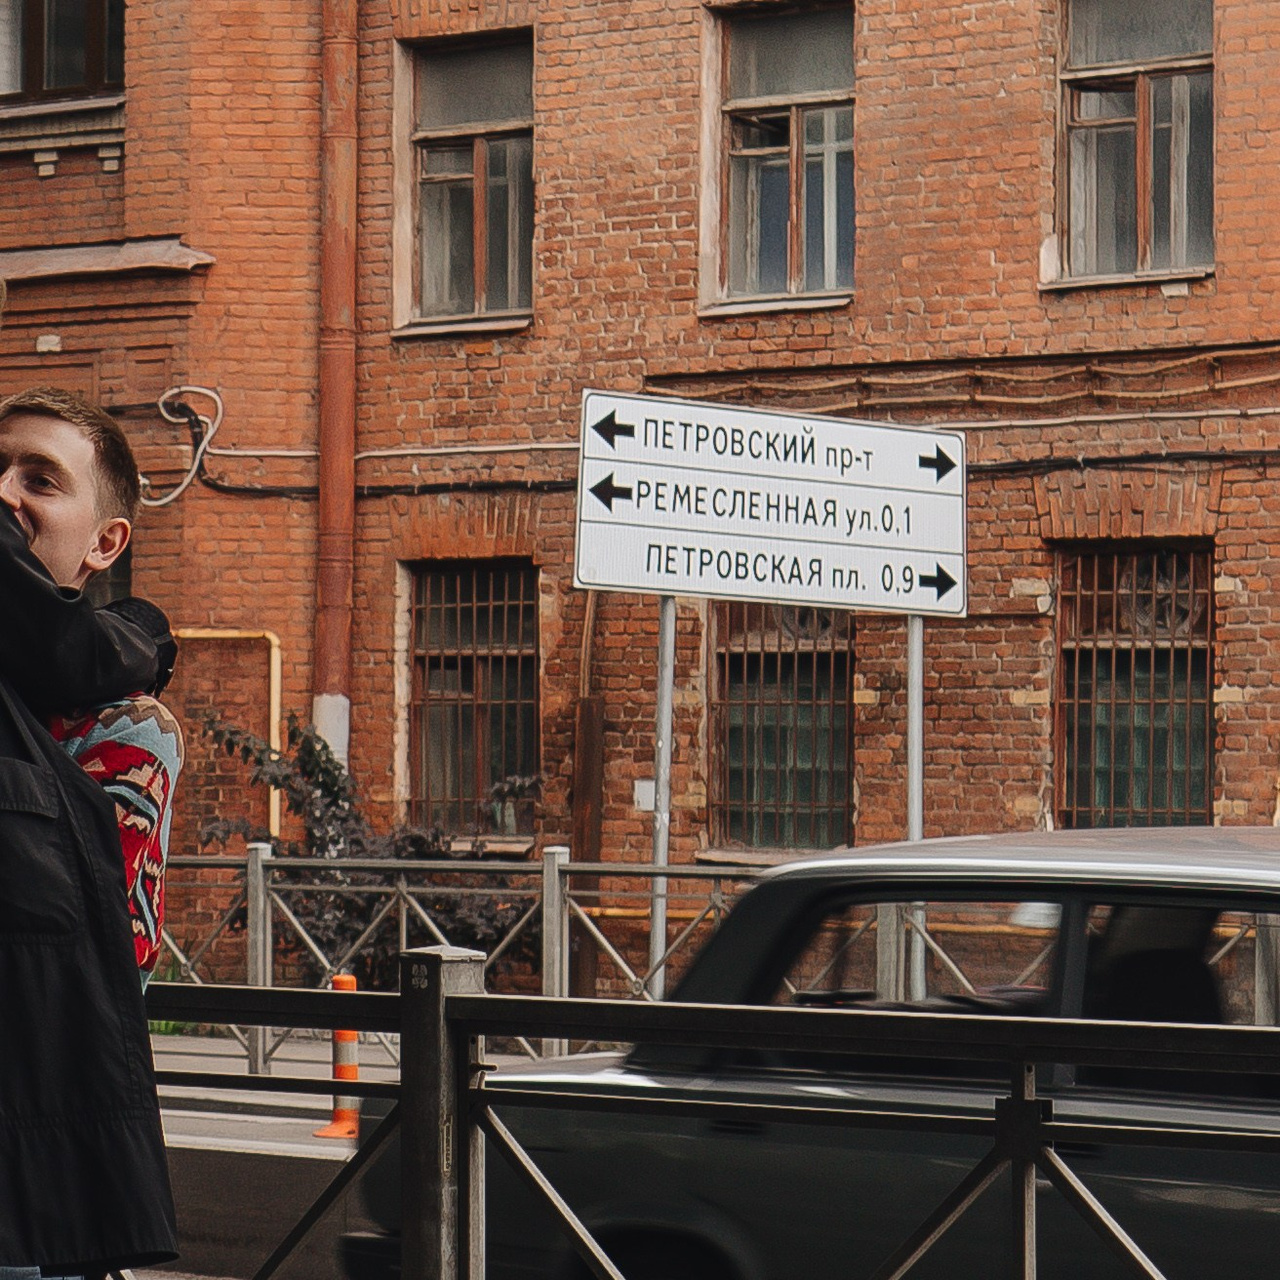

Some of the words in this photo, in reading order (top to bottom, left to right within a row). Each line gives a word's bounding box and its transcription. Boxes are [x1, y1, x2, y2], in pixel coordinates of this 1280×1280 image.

[643, 418, 816, 466] ПЕТРОВСКИЙ
[825, 447, 874, 477] пр-т
[636, 480, 838, 527] РЕМЕСЛЕННАЯ
[646, 543, 823, 587] ПЕТРОВСКАЯ
[832, 568, 867, 590] пл.
[881, 564, 915, 595] 0,9
